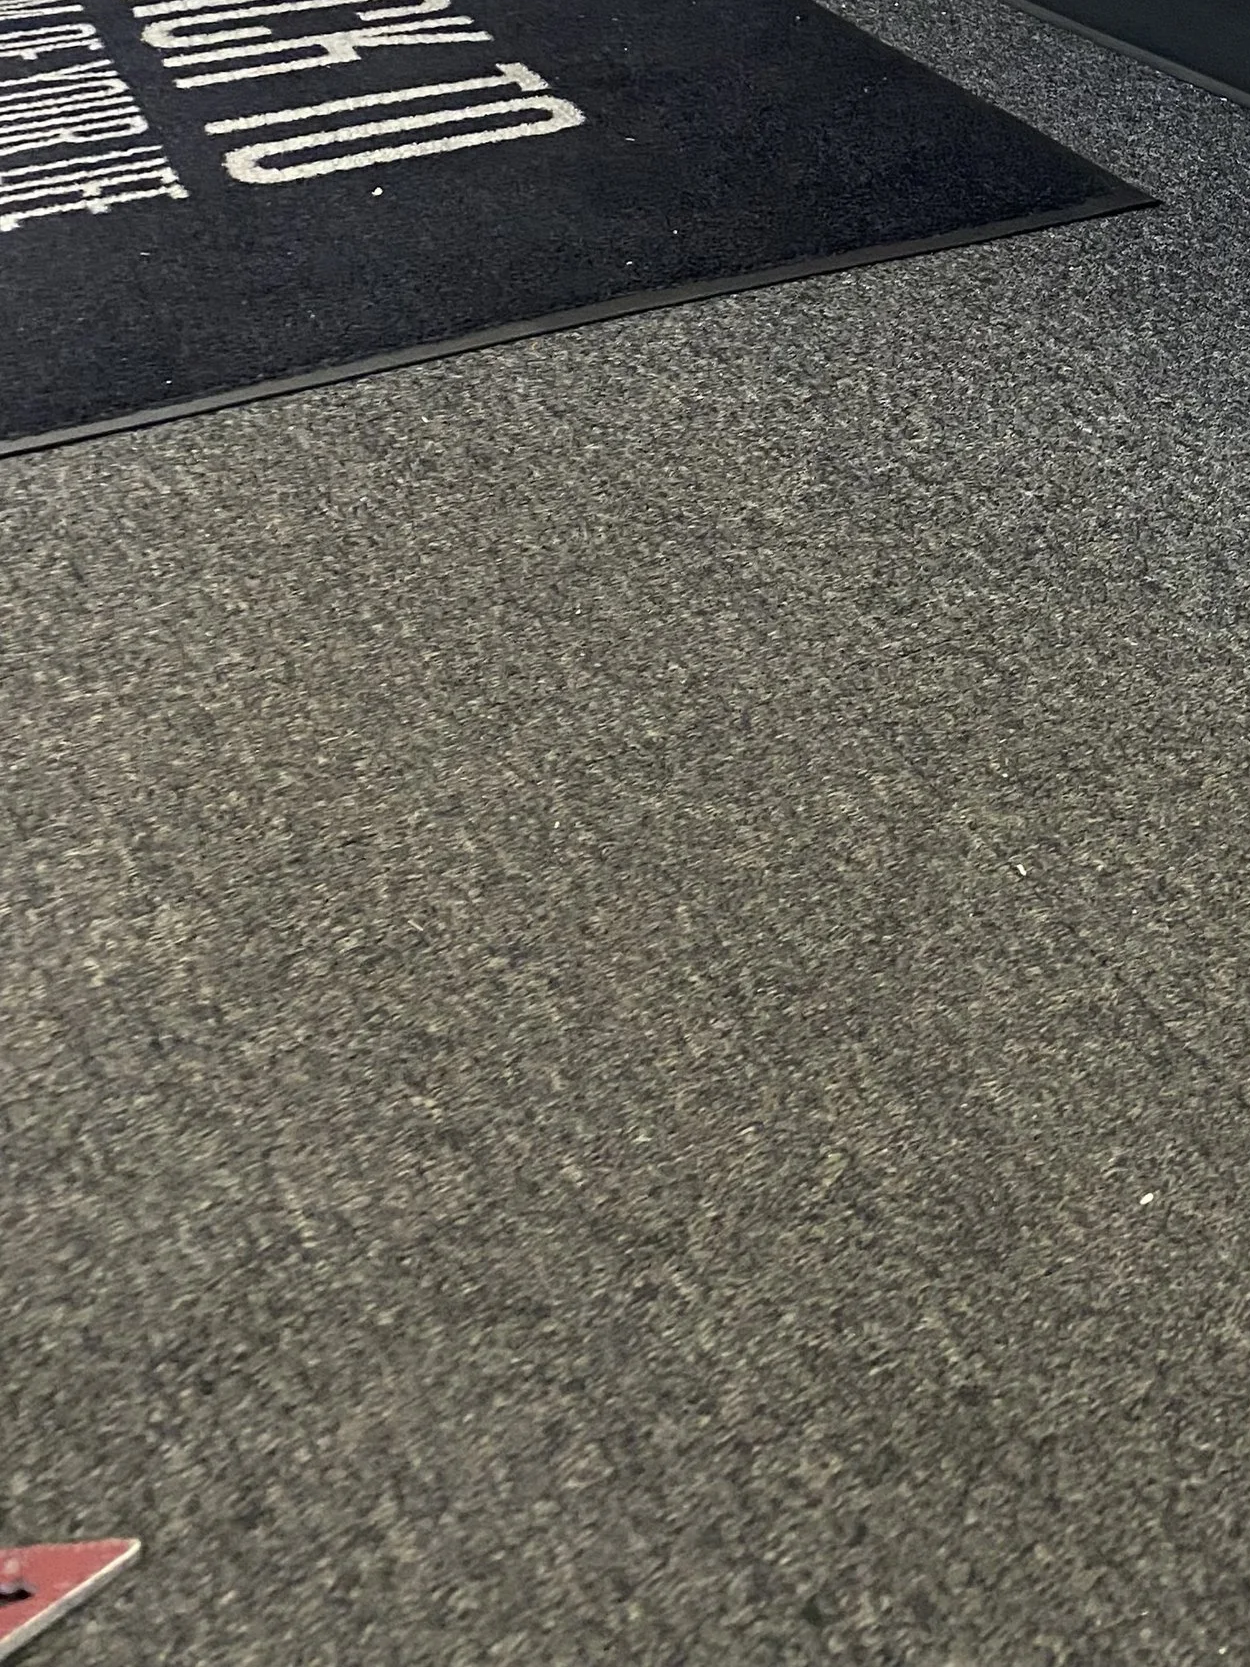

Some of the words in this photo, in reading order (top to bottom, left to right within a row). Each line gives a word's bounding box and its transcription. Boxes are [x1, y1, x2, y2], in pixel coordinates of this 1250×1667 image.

[0, 23, 105, 60] OF
[0, 59, 149, 156] YOUR
[205, 63, 587, 184] TO
[0, 145, 190, 232] LIFE
